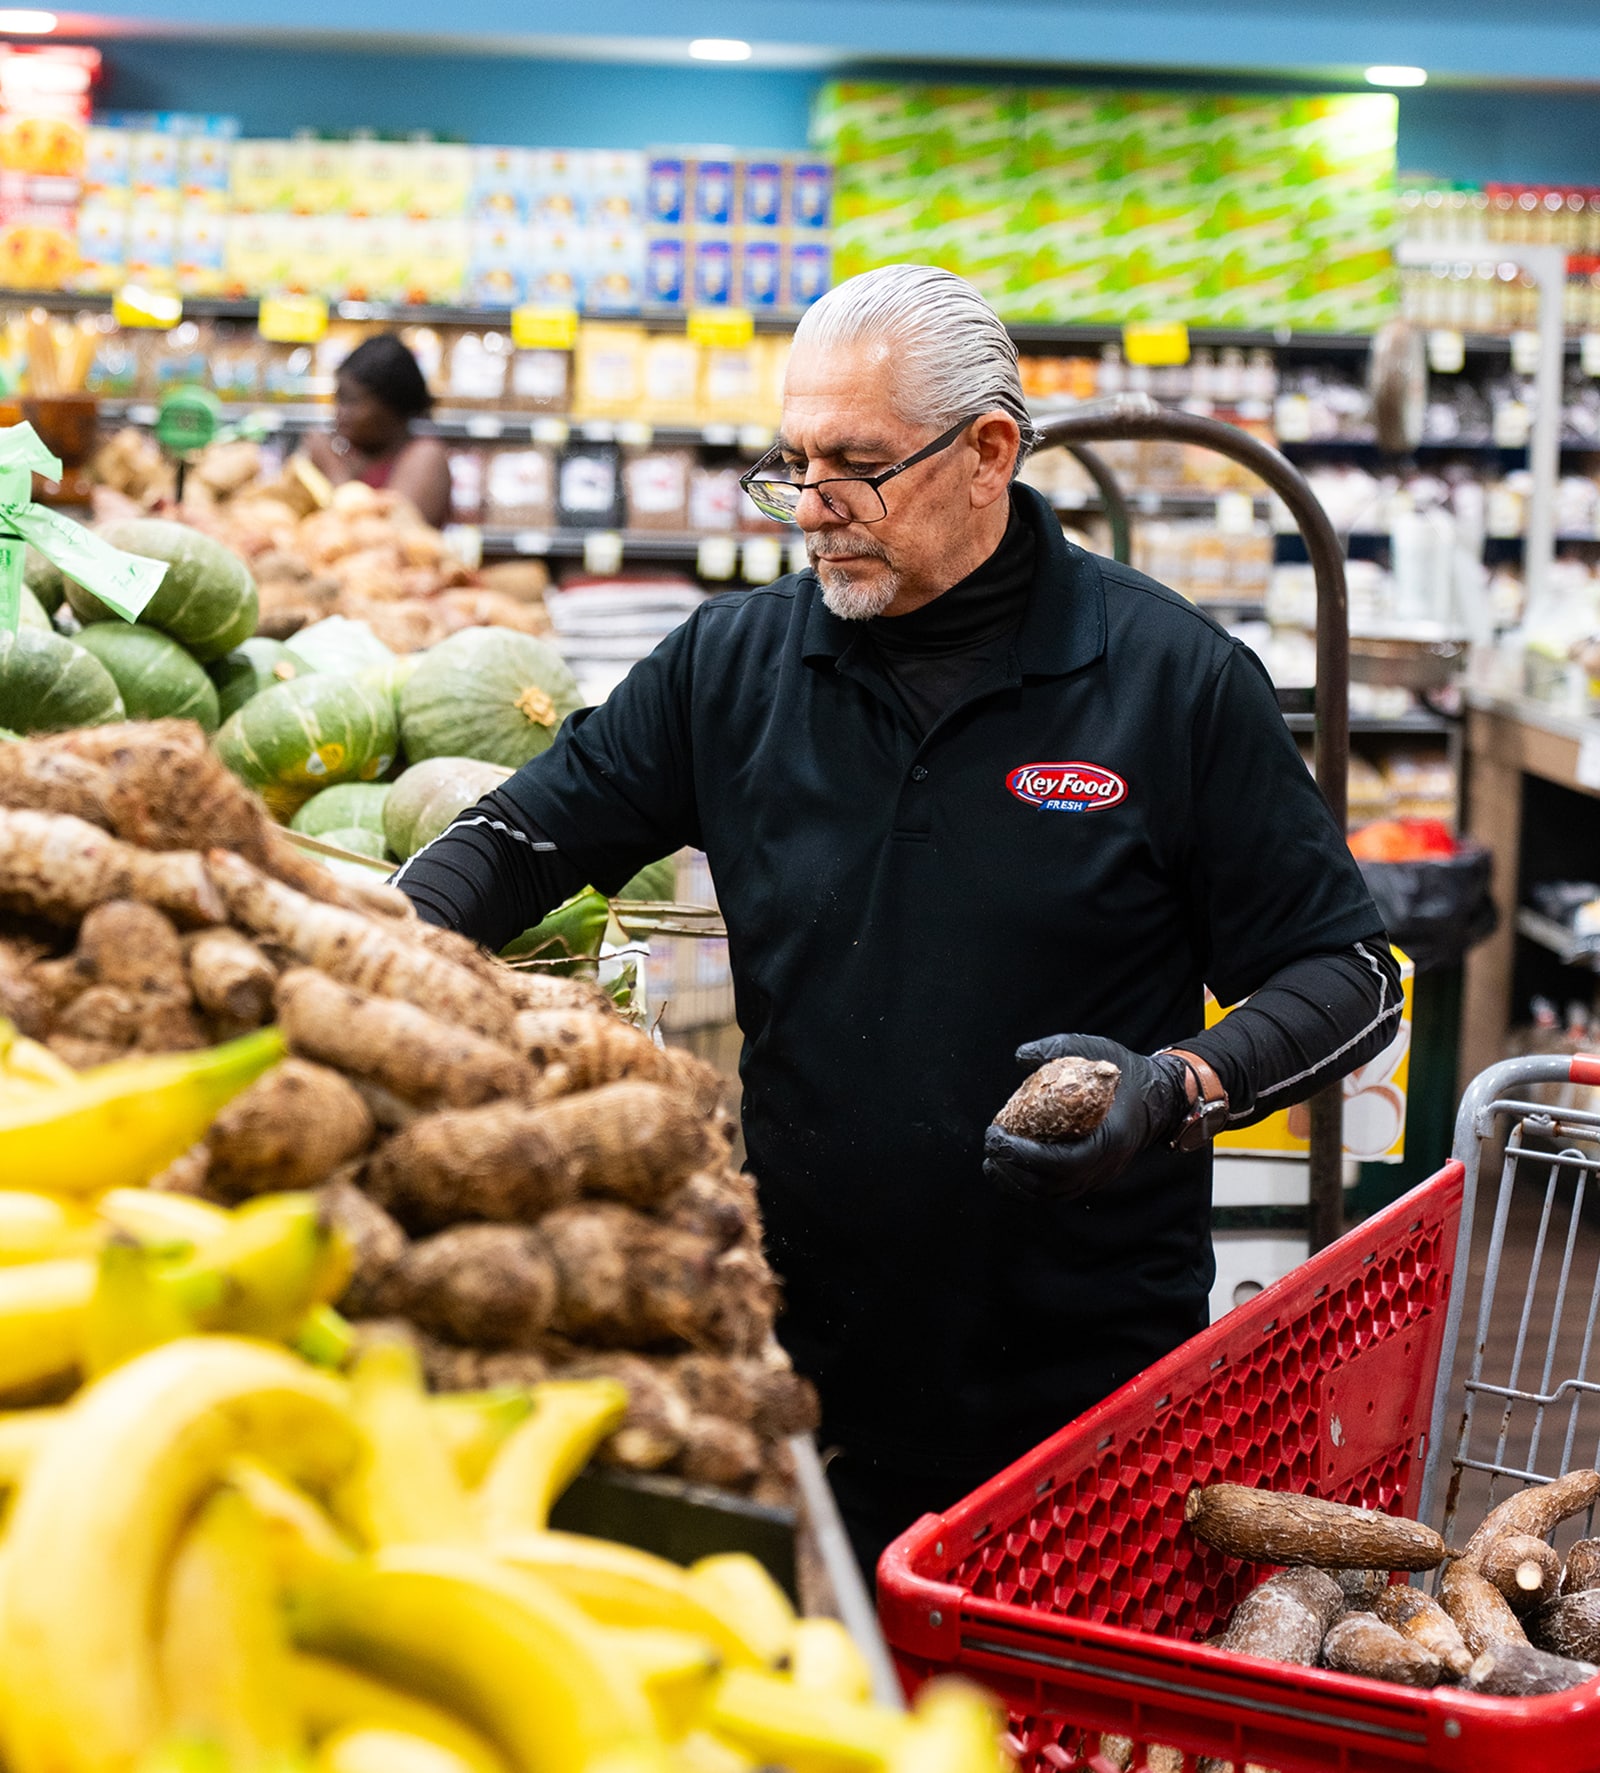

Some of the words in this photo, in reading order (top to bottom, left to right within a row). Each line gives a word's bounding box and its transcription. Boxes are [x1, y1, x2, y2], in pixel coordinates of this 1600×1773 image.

[1016, 770, 1059, 796] Key
[1058, 773, 1115, 797] Food
[1046, 800, 1083, 811] FRESH
